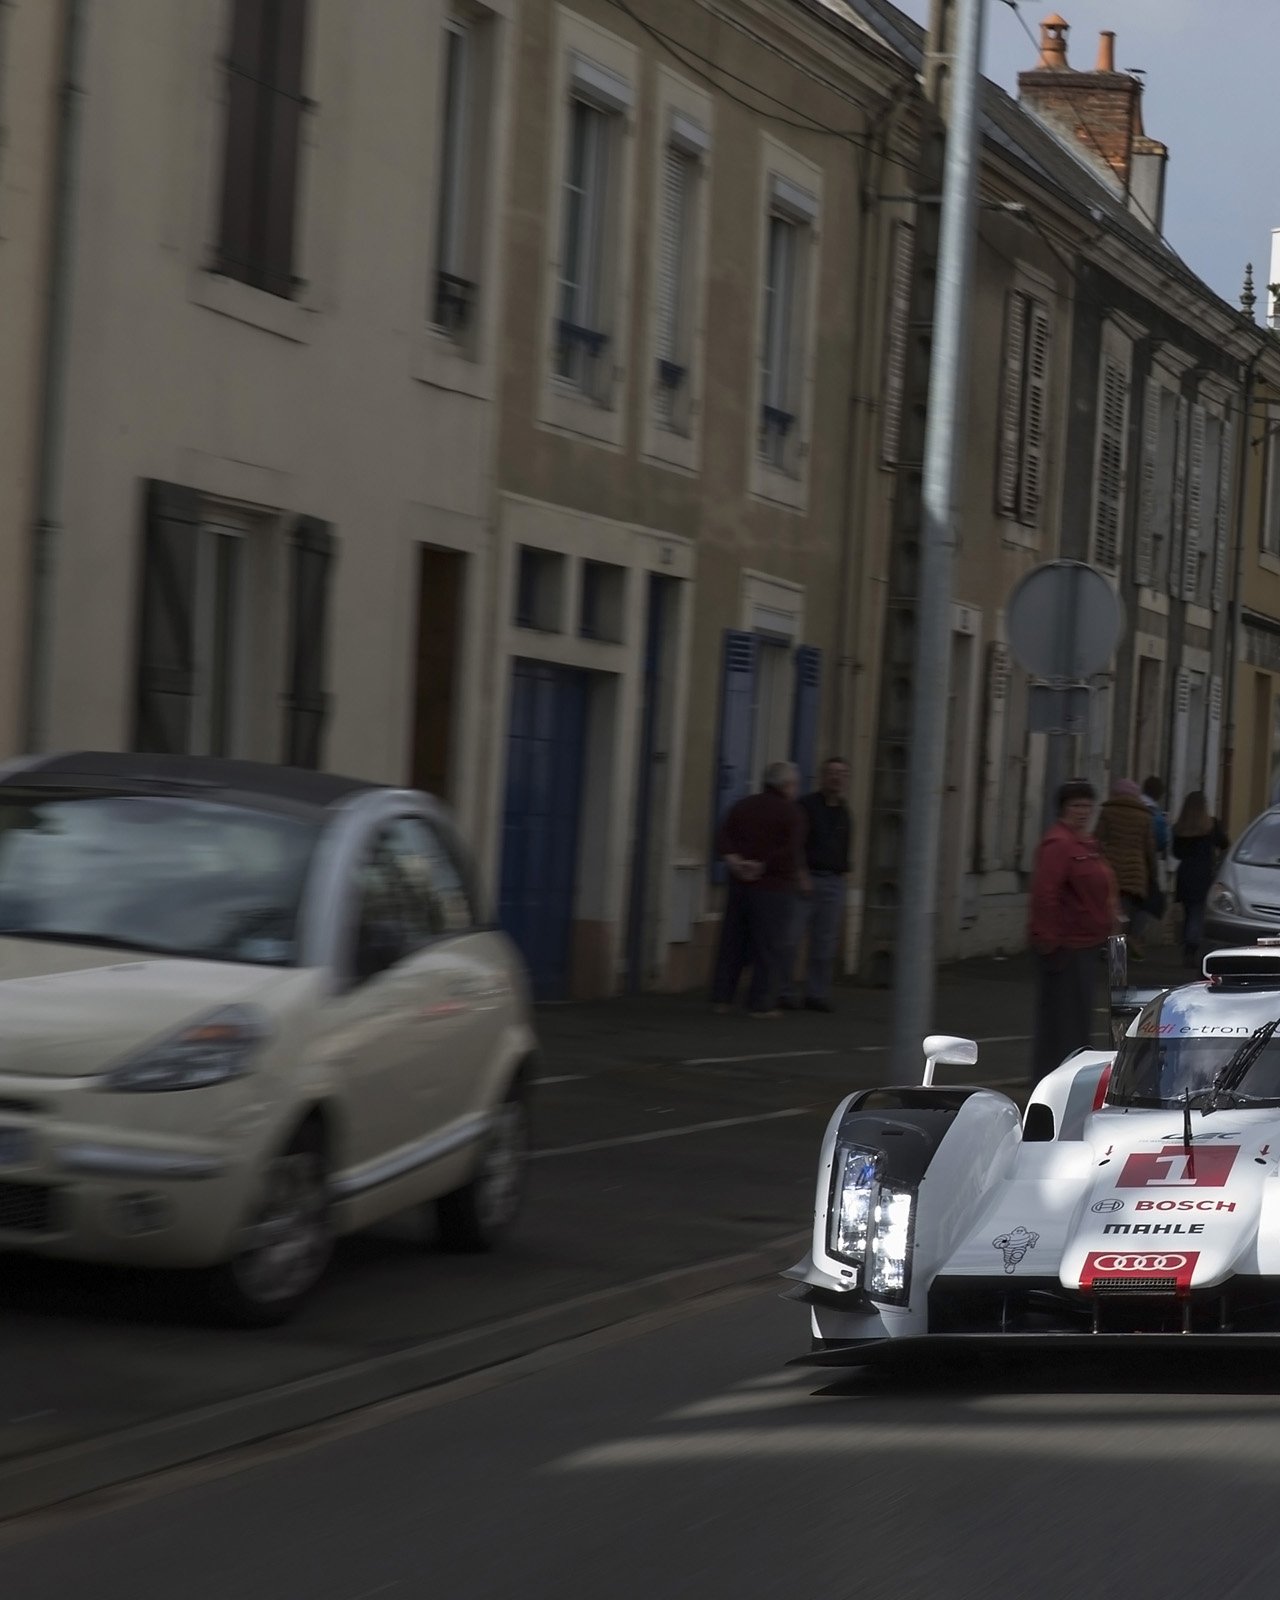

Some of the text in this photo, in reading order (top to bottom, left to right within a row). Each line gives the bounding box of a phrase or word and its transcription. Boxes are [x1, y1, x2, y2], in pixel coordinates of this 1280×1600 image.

[1141, 1022, 1176, 1034] Audi
[1180, 1025, 1249, 1034] e-tron
[1146, 1154, 1198, 1186] 1
[1135, 1200, 1237, 1212] BOSCH
[1103, 1224, 1205, 1235] MAHLE
